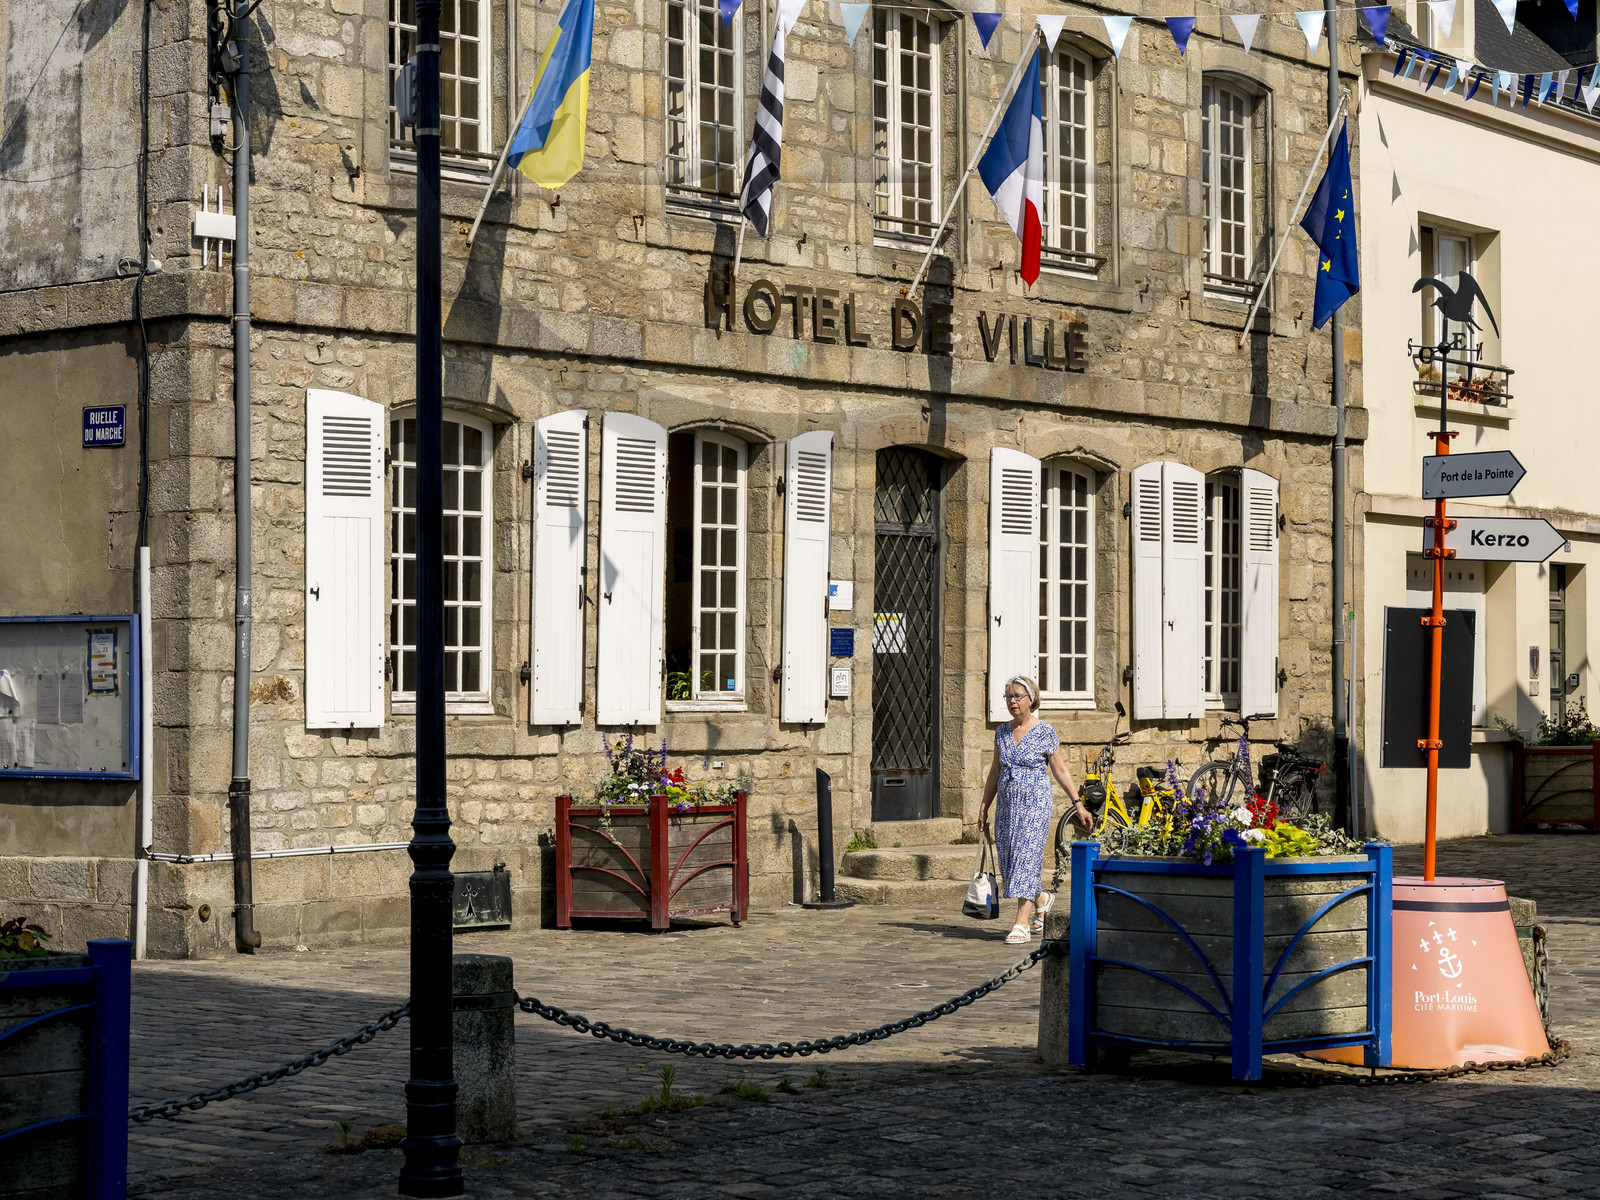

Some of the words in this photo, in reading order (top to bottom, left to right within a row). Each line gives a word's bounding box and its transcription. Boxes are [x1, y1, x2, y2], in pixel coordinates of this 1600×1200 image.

[706, 272, 872, 344] HOTEL
[895, 298, 953, 351] DE
[979, 311, 1089, 369] VILLE
[1452, 332, 1467, 350] E
[90, 411, 118, 424] RUELLE
[85, 429, 93, 441] DU
[96, 424, 122, 440] MARCHÉ
[1441, 471, 1459, 482] Port
[1461, 469, 1473, 481] de
[1474, 469, 1483, 480] la
[1485, 468, 1514, 480] Pointe
[1470, 529, 1530, 548] Kerzo
[1414, 990, 1477, 1004] Port-Louis
[1414, 1003, 1434, 1012] CITÉ
[1437, 1003, 1478, 1012] MARITIME
